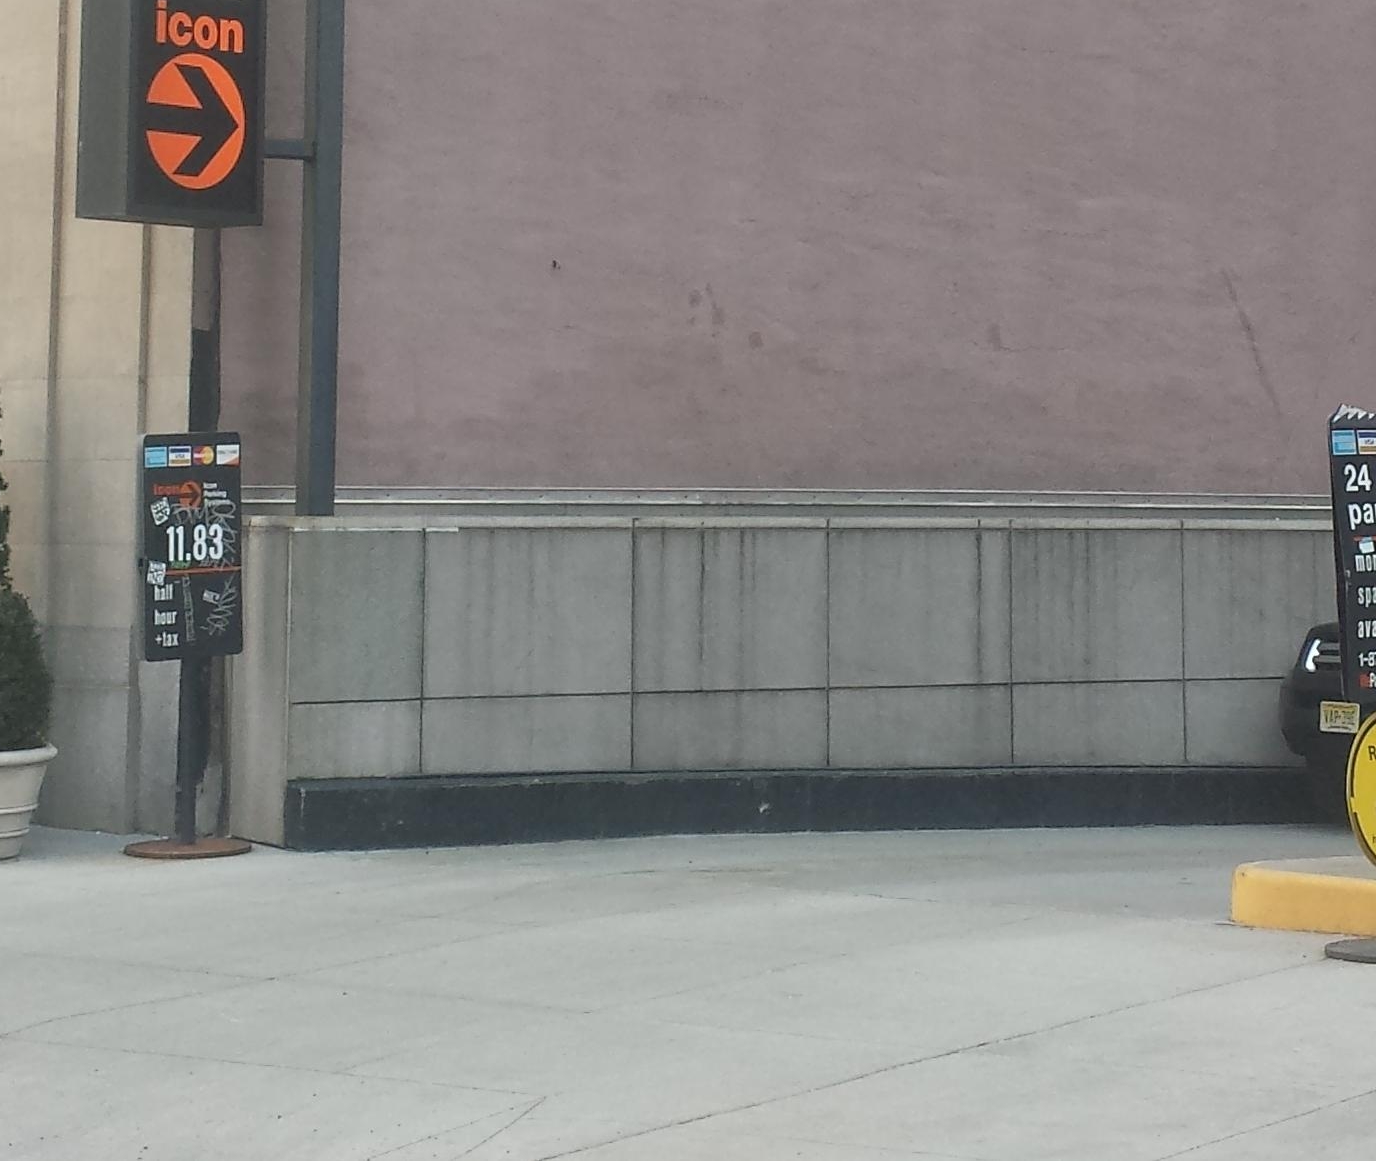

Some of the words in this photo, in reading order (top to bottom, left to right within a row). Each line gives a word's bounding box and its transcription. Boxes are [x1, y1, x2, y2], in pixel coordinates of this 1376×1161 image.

[1344, 464, 1372, 492] 24
[166, 524, 224, 562] 11.83
[154, 609, 177, 625] hour
